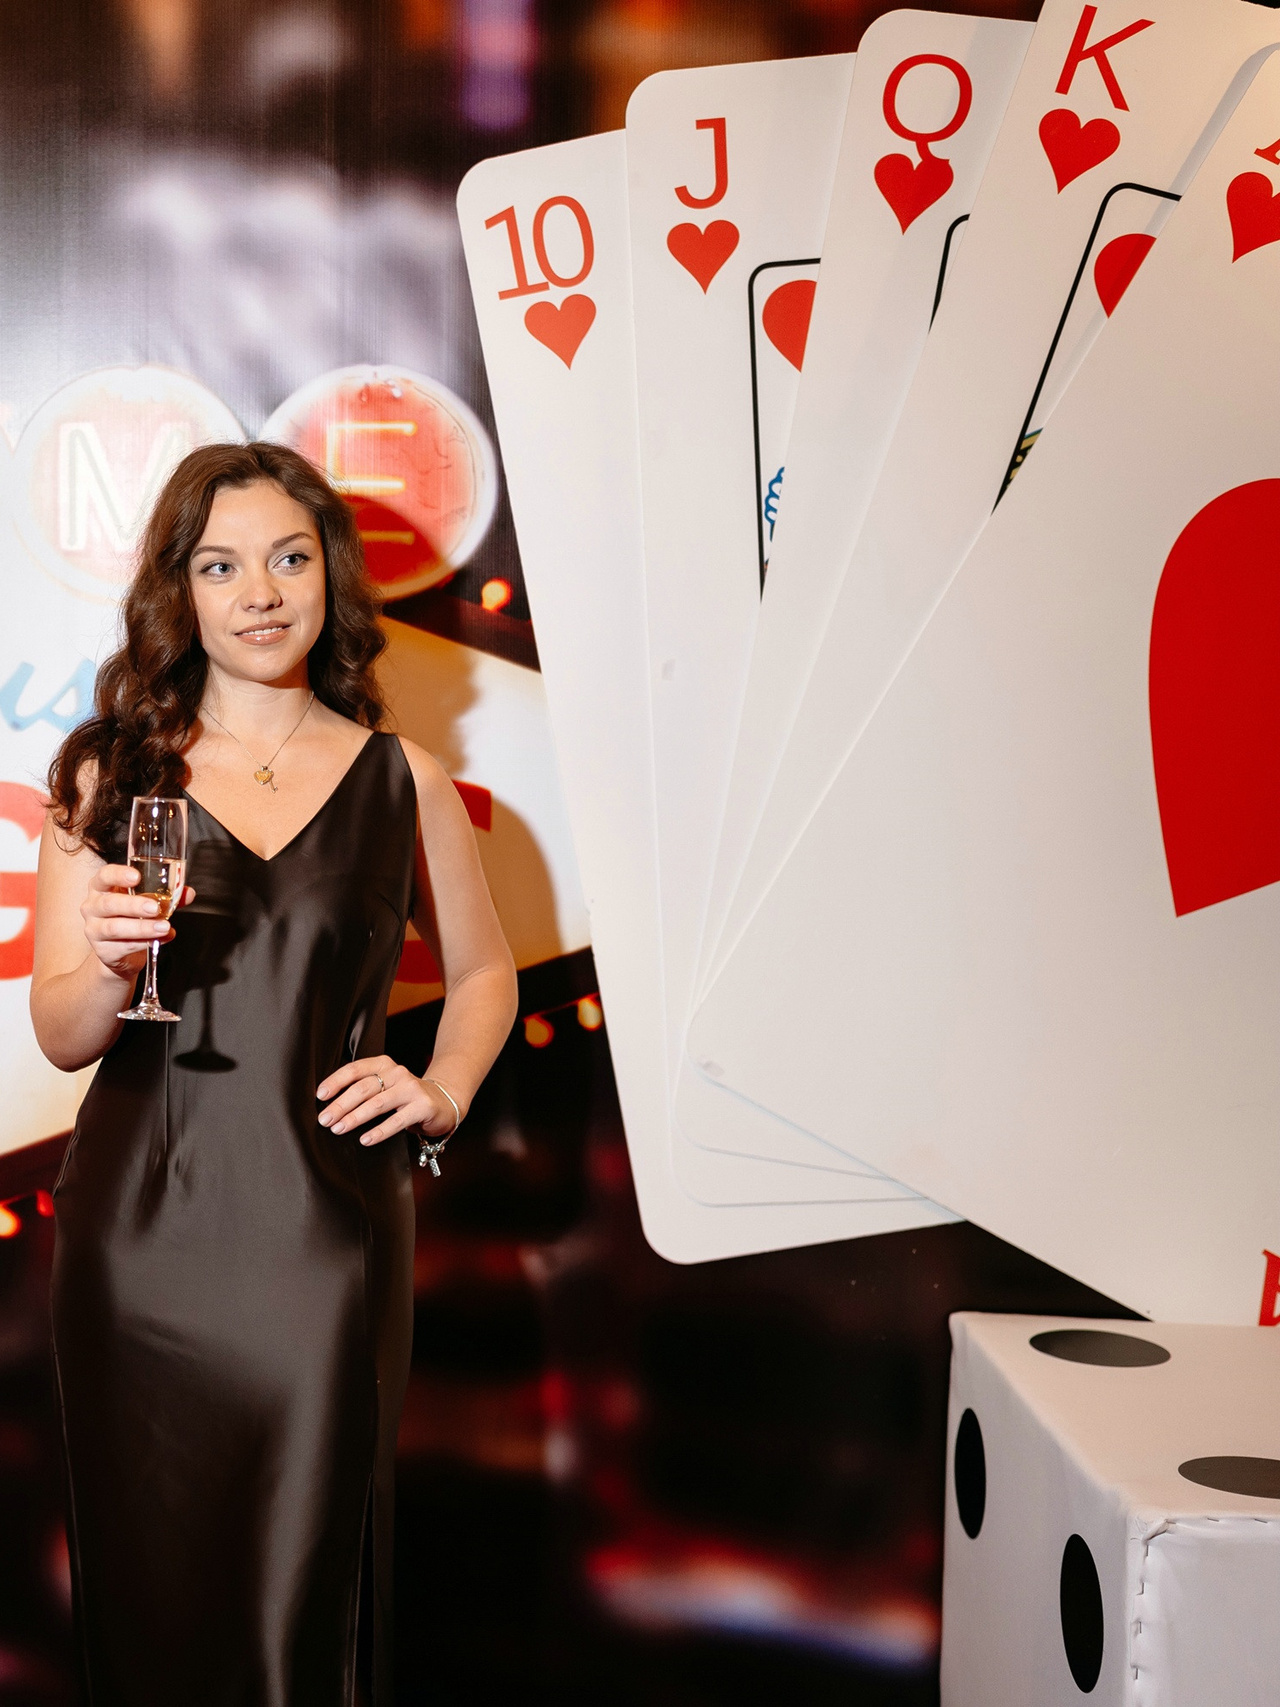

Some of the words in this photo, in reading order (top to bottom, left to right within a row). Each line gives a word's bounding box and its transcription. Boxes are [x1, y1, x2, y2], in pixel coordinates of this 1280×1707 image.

[881, 53, 974, 161] Q
[1055, 4, 1155, 112] K
[674, 116, 729, 211] J
[483, 195, 596, 301] 10
